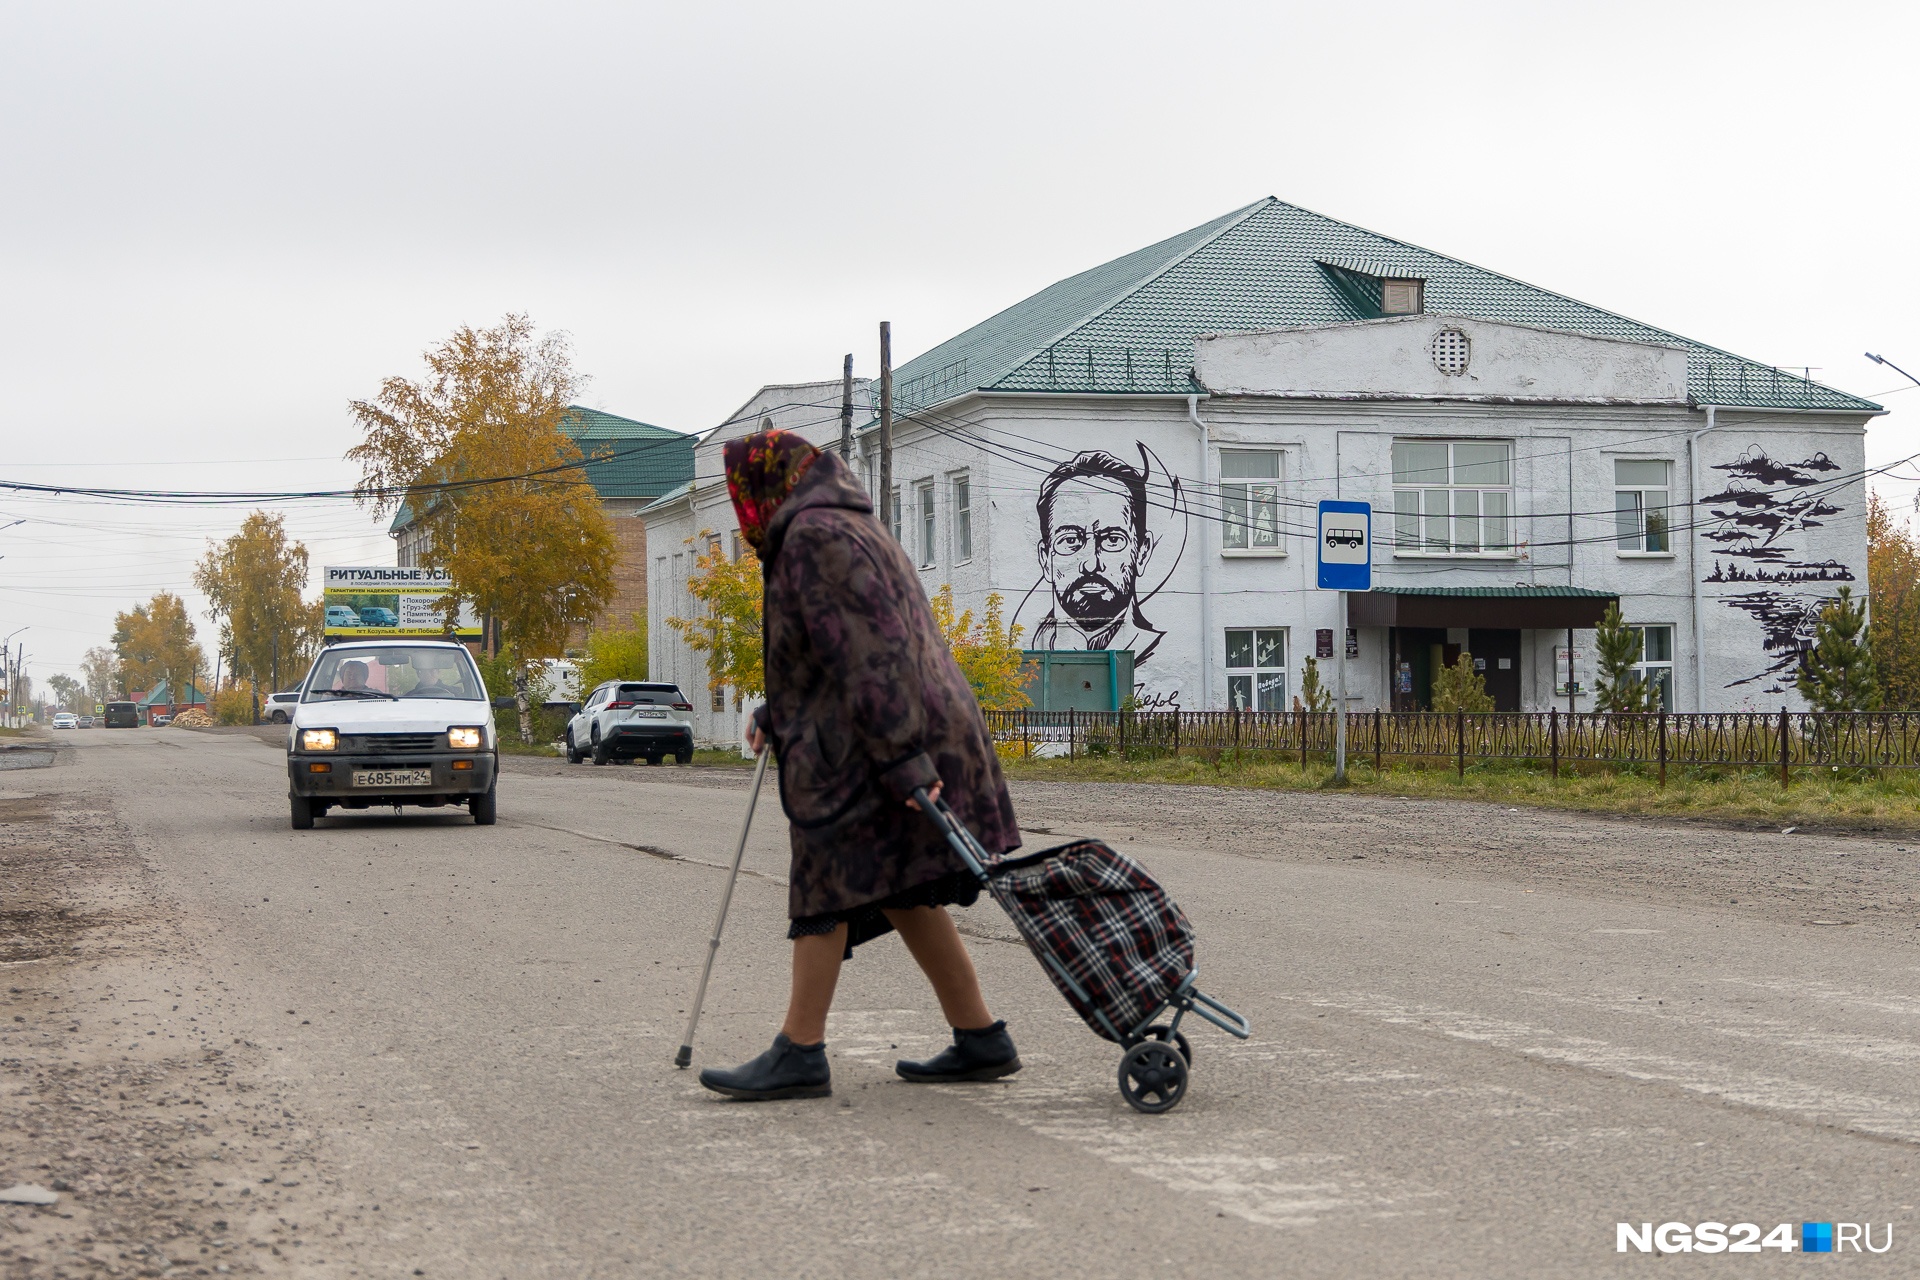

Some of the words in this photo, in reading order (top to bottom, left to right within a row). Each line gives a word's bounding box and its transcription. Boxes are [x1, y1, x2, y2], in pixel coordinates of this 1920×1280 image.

[330, 570, 421, 580] РИТУАЛЬНЫЕ
[426, 570, 452, 580] УСЛ
[413, 770, 427, 781] 24
